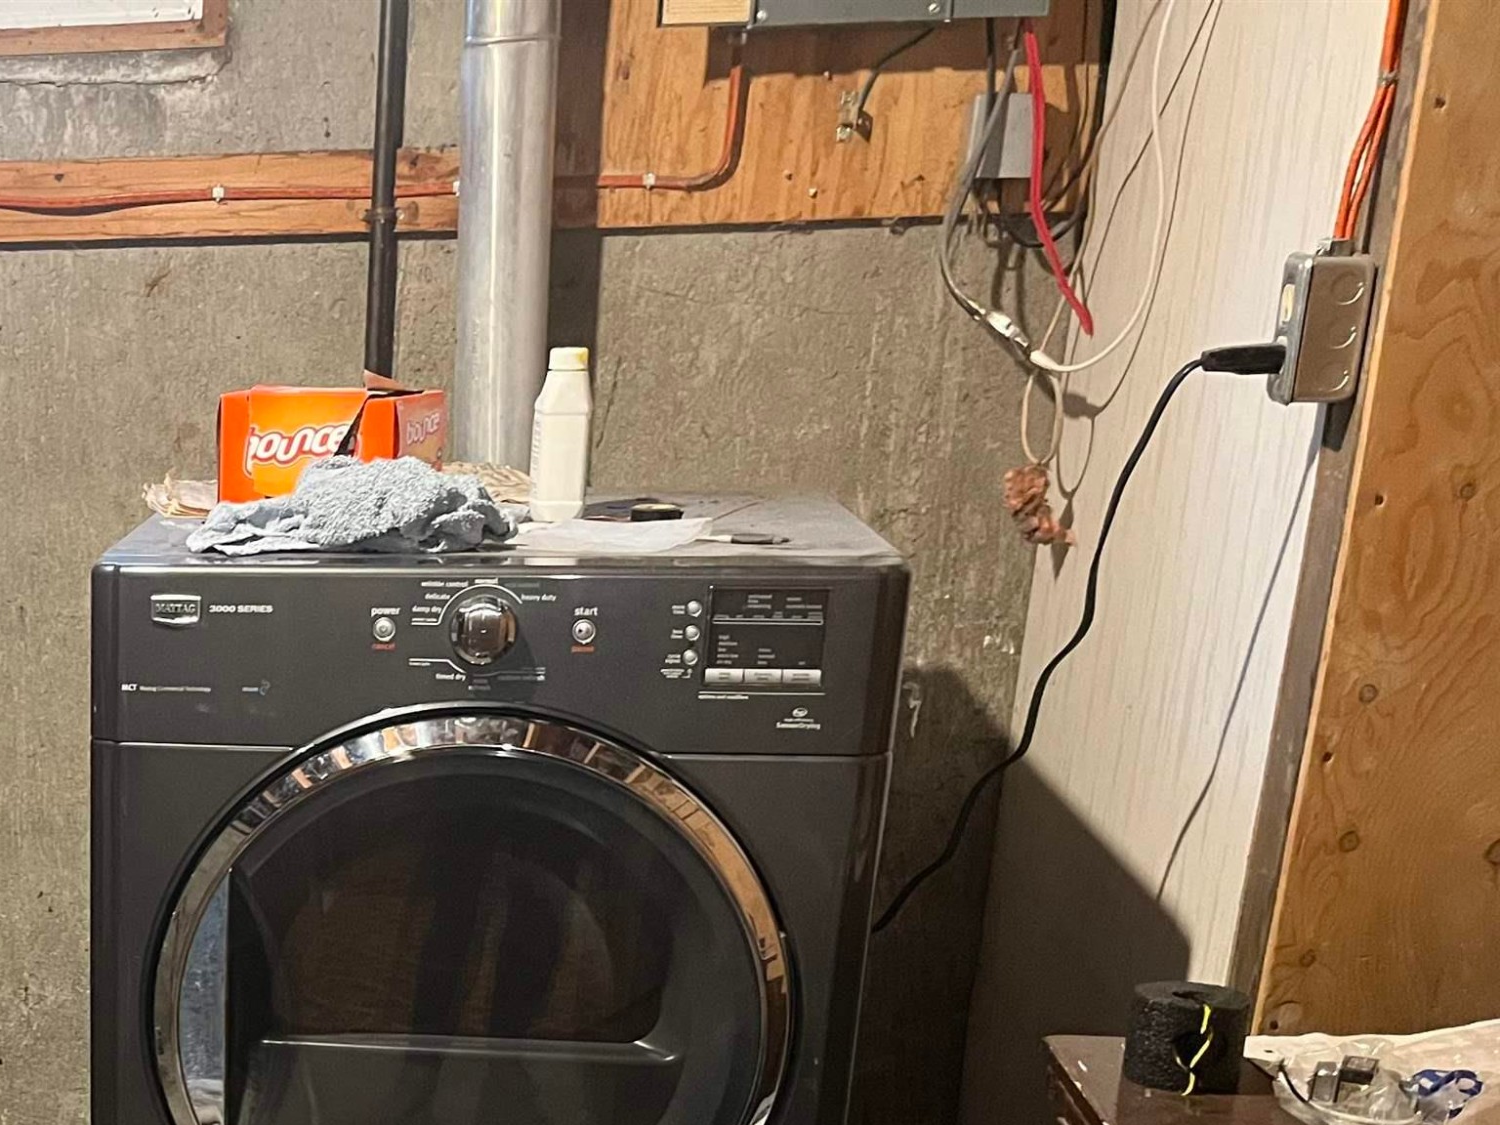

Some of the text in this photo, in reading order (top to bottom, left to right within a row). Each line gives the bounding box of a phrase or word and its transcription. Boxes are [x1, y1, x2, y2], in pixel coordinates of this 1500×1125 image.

[406, 410, 441, 445] bounce
[237, 604, 274, 613] SERIES
[371, 607, 401, 616] power
[574, 607, 598, 616] start
